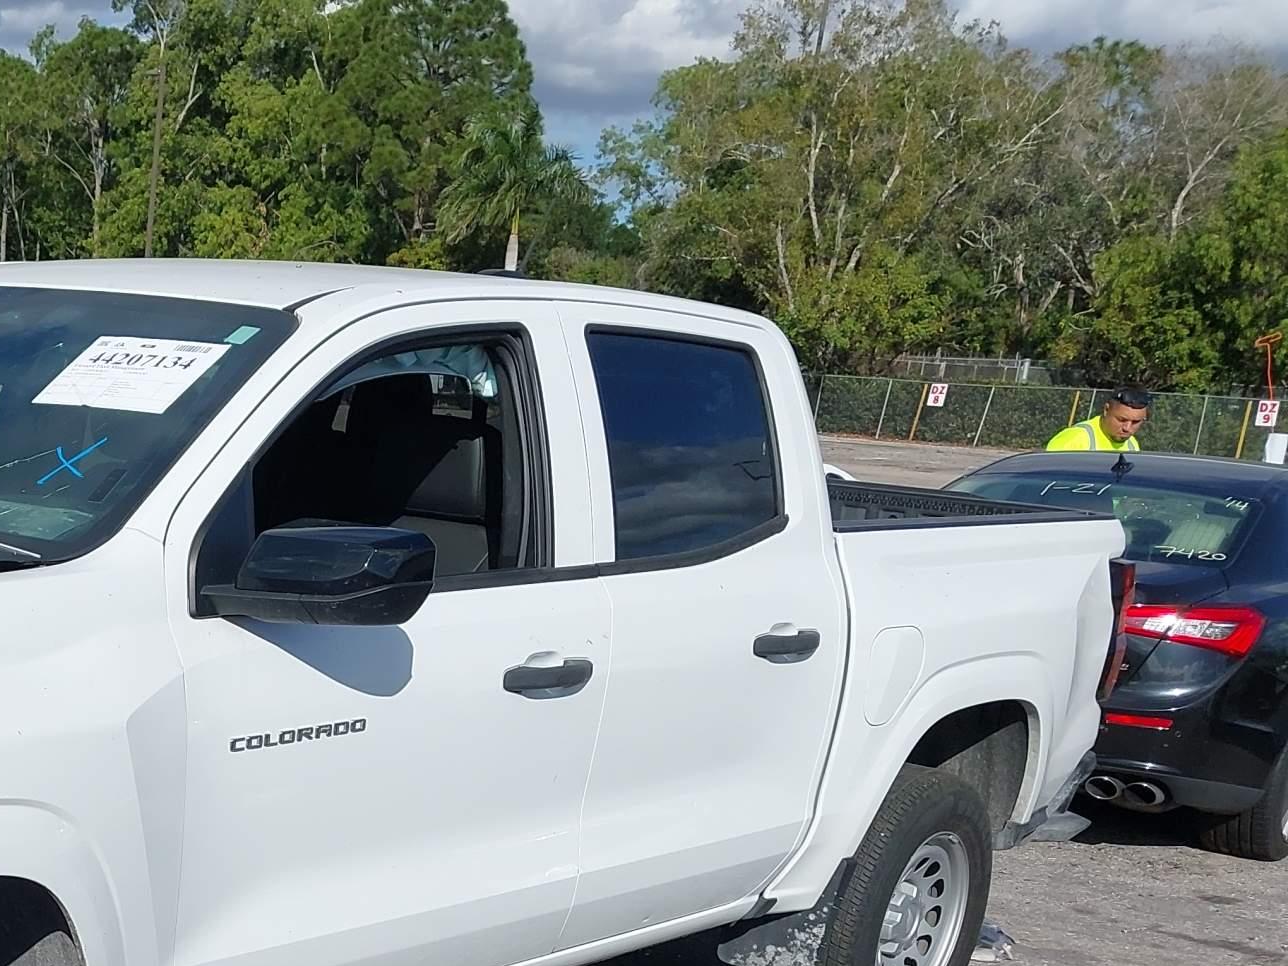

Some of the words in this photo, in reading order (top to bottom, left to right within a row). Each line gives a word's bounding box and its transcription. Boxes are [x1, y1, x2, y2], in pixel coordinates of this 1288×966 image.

[89, 352, 197, 370] 44207134
[931, 385, 946, 395] DZ
[932, 395, 940, 405] 8
[1259, 402, 1278, 413] DZ
[1262, 414, 1271, 424] 9
[1040, 480, 1112, 496] 1-21
[229, 718, 367, 752] COLORADO
